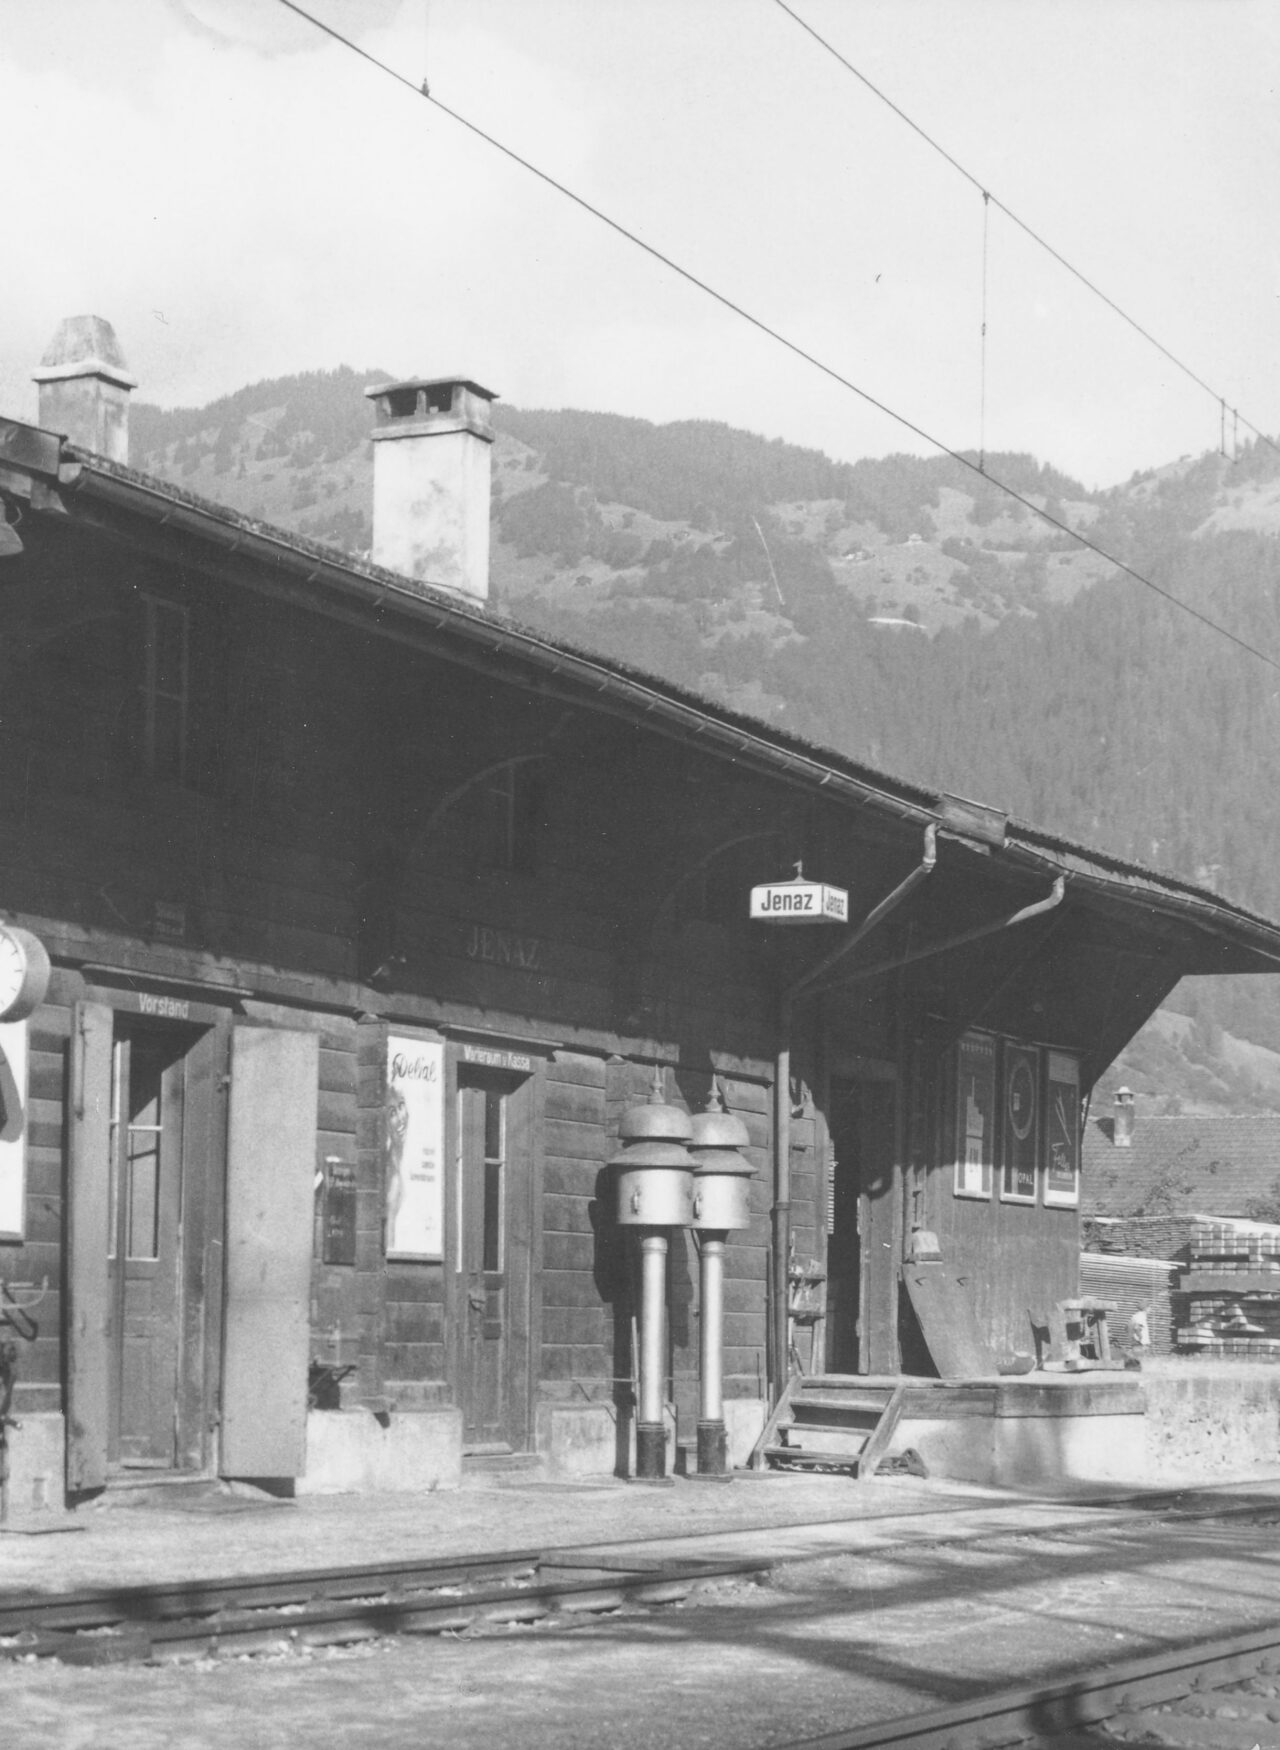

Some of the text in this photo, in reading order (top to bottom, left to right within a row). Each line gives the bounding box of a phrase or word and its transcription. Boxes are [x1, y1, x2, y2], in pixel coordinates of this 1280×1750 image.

[761, 889, 813, 911] Jenaz
[825, 889, 845, 916] Jenaz
[467, 926, 540, 970] JENAZ
[139, 992, 190, 1019] Vorstand
